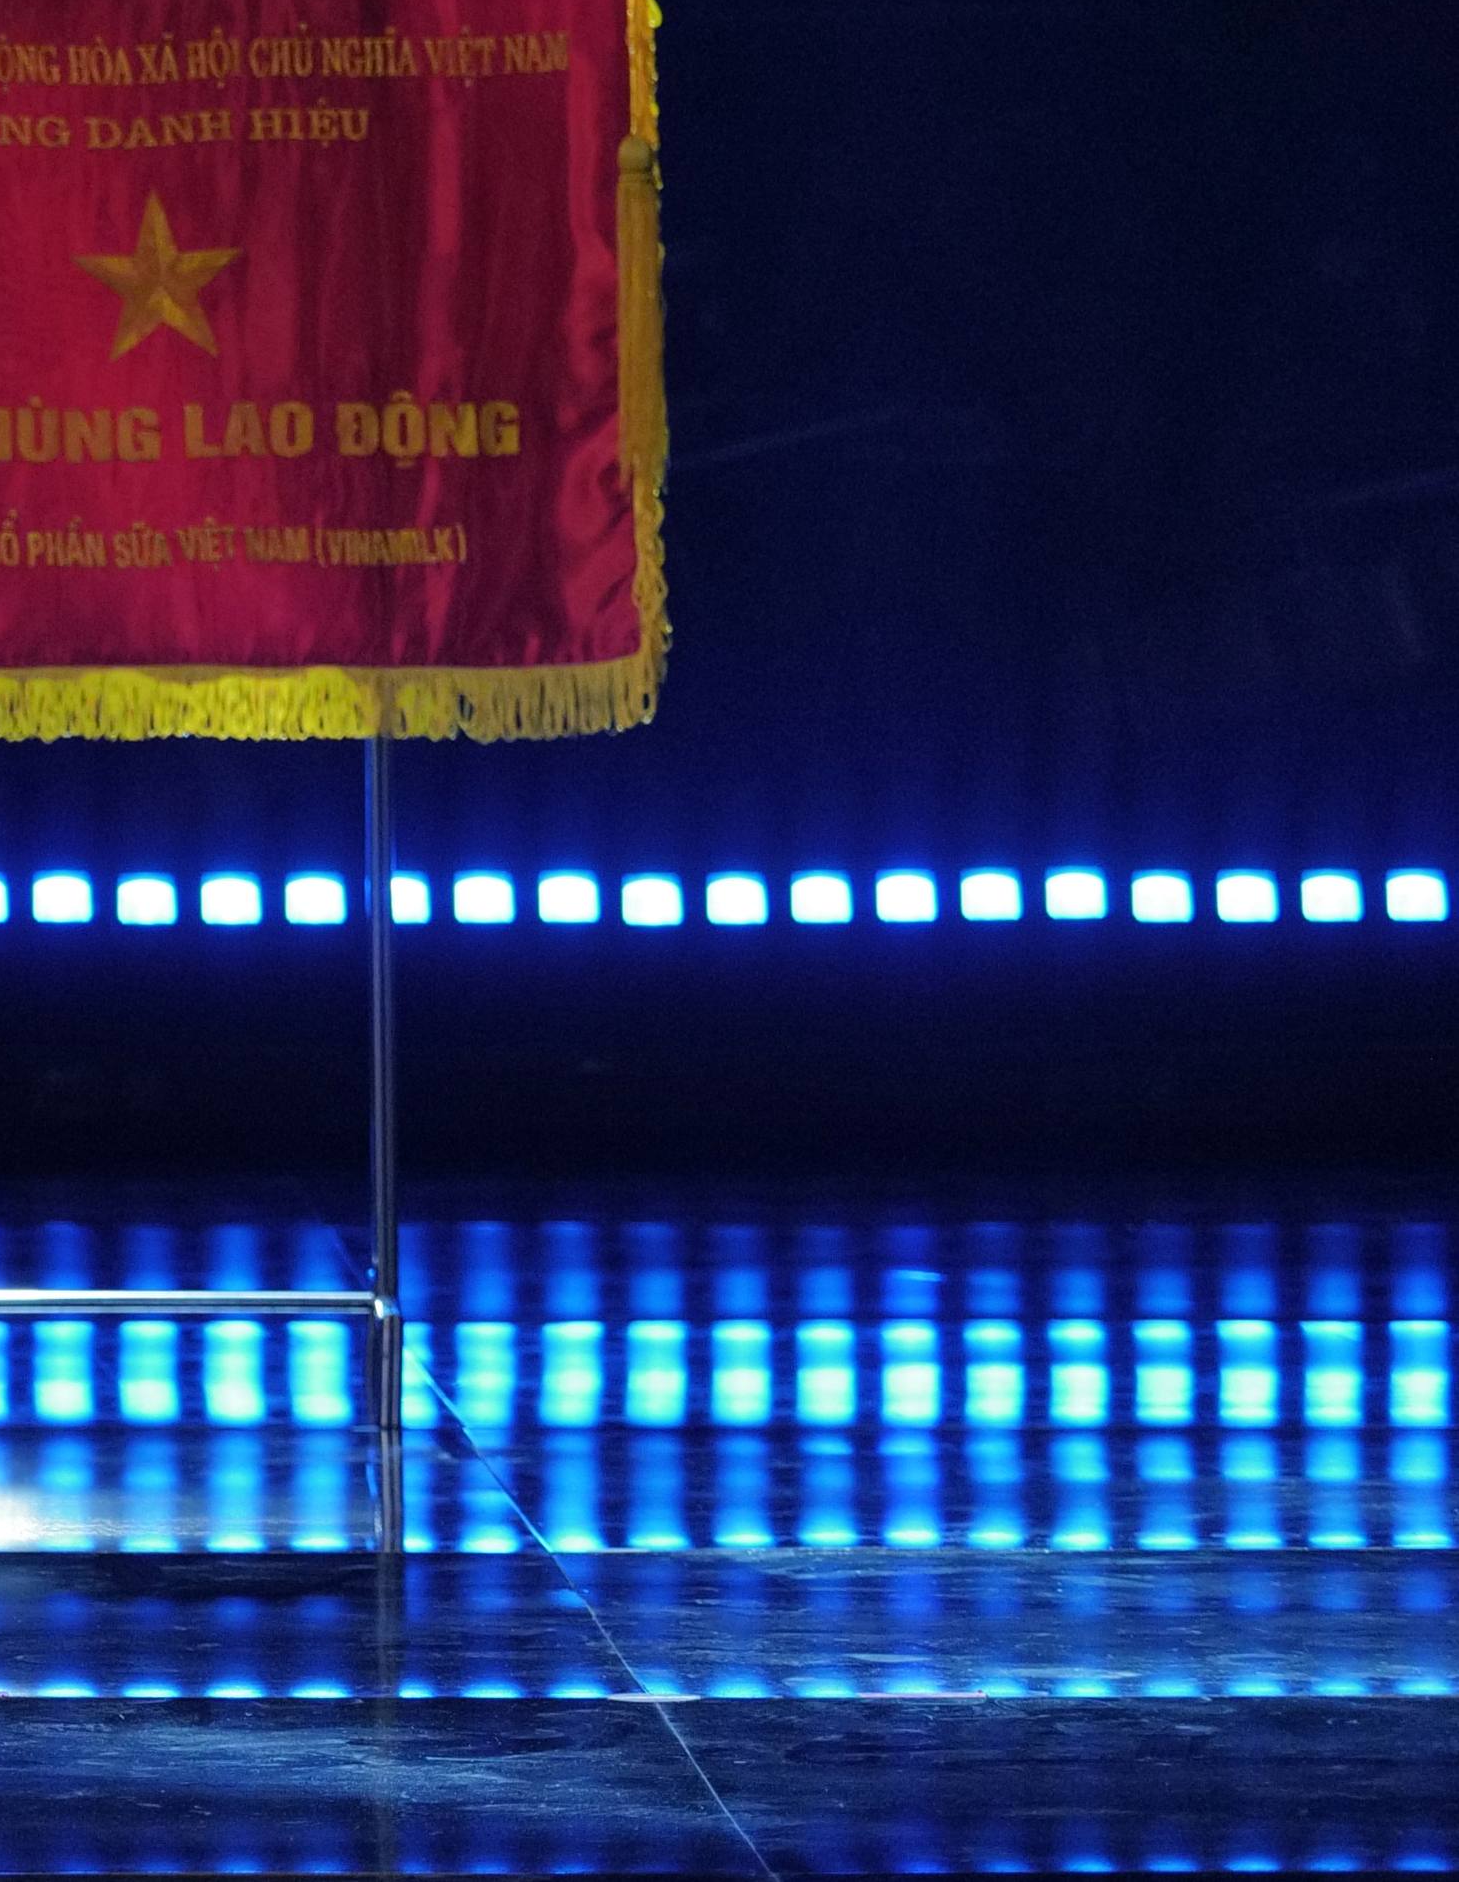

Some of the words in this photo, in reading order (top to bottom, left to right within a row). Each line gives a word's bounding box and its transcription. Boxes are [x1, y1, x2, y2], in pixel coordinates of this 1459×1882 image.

[68, 36, 133, 86] HÒA
[186, 26, 240, 89] HỘI
[248, 21, 314, 79] CHỦ
[321, 25, 418, 78] NGHĨA
[423, 24, 497, 89] VIỆT
[503, 29, 570, 74] NAM
[85, 108, 234, 150] DANH
[248, 96, 370, 149] HIỆU
[183, 400, 316, 459] LAO
[334, 389, 521, 468] ĐỘNG
[112, 520, 172, 570] SỮA
[175, 515, 236, 571] VIỆT
[243, 524, 312, 563] NAM
[314, 522, 468, 569] (VINAMILK)
